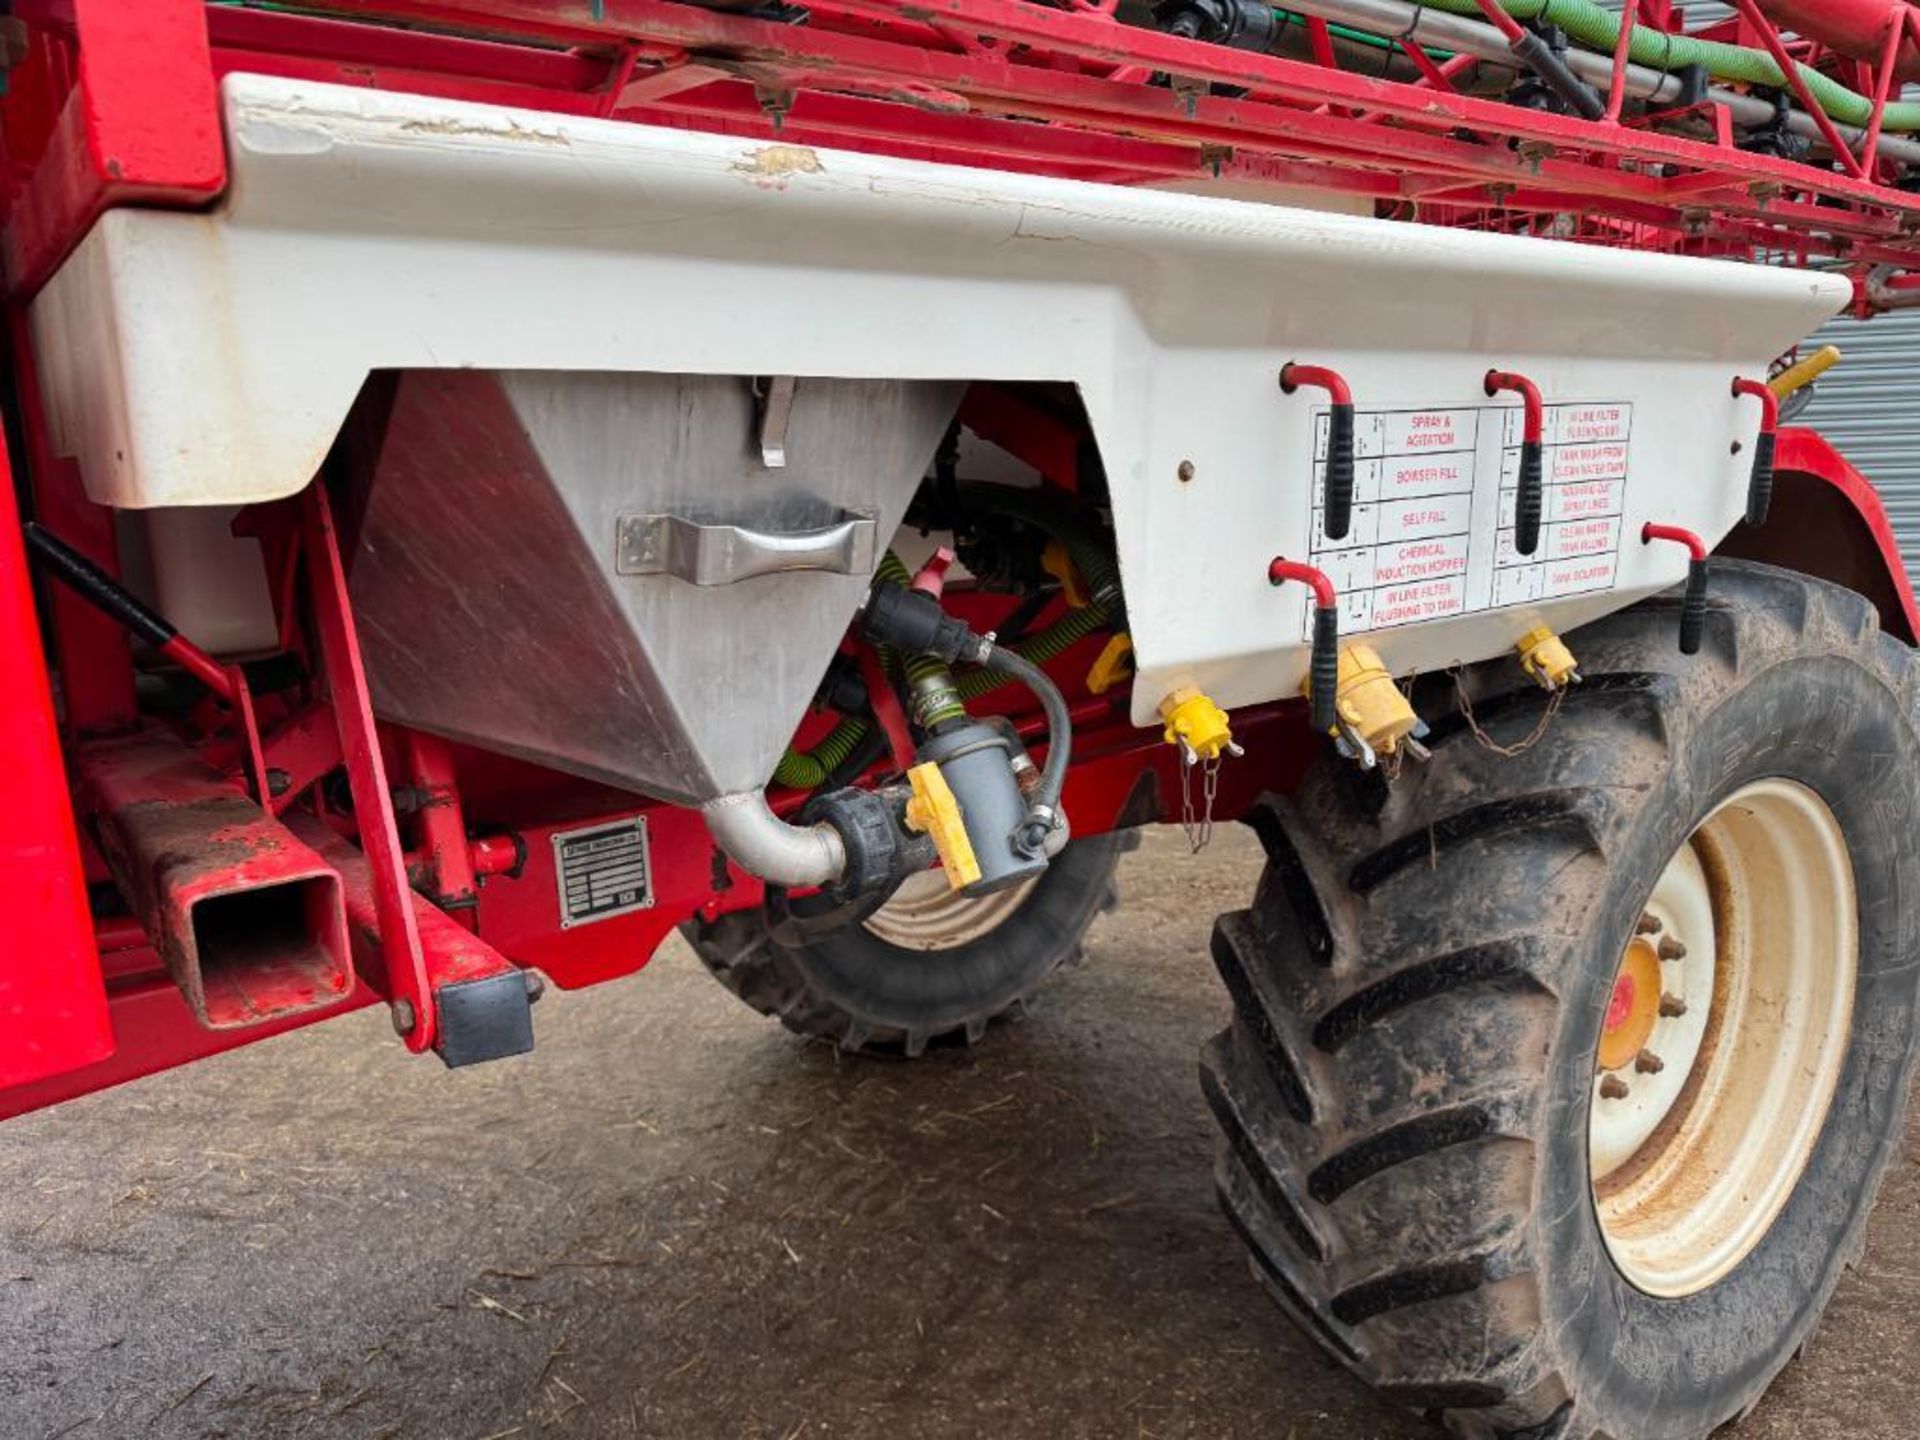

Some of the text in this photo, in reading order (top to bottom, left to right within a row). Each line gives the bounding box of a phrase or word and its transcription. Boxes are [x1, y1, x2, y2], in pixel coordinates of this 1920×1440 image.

[1411, 415, 1440, 429] SPRAY
[1407, 432, 1455, 447] AGITATION
[1396, 466, 1458, 484] BOWSER FILL
[1403, 512, 1427, 527] SELF
[1399, 543, 1446, 561] CHEMICAL
[1376, 557, 1466, 581] INDUCTION HOPPER
[1422, 583, 1451, 597] FILTER
[1375, 604, 1421, 624] FLUSHING
